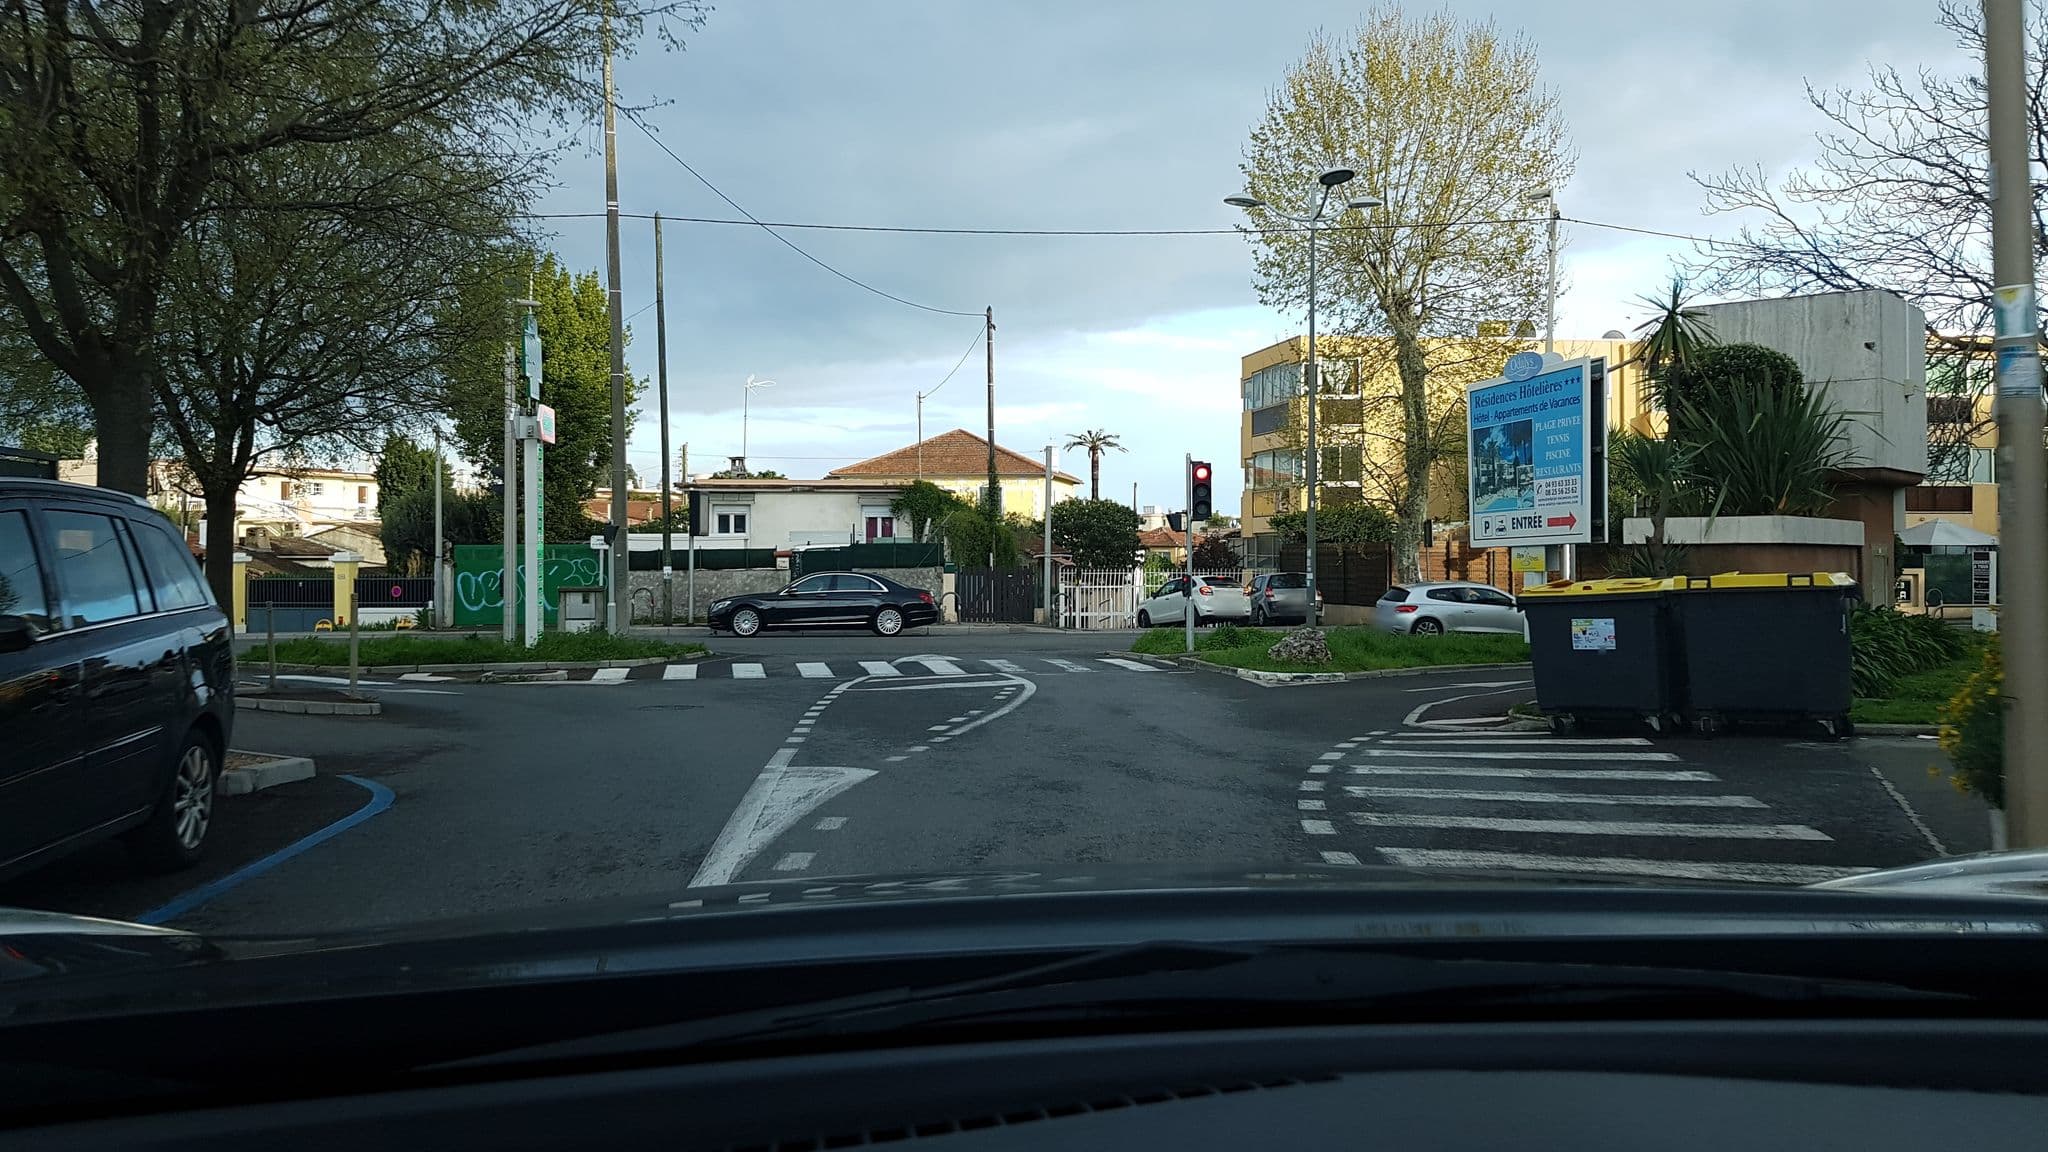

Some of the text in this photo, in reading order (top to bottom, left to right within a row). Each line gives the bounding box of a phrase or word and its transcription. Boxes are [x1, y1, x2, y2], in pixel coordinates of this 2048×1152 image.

[1475, 380, 1563, 409] Résidences Hôtelières
[1473, 410, 1490, 425] Hôtel
[1494, 403, 1538, 421] Appartements
[1539, 400, 1548, 411] de
[1549, 395, 1581, 410] Vacances
[1535, 420, 1557, 432] PLAGE
[1546, 433, 1570, 445] TENNIS
[1545, 448, 1571, 461] PISCINE
[1535, 463, 1582, 477] RESTAURANTS
[1484, 511, 1543, 534] P ENTRÉE
